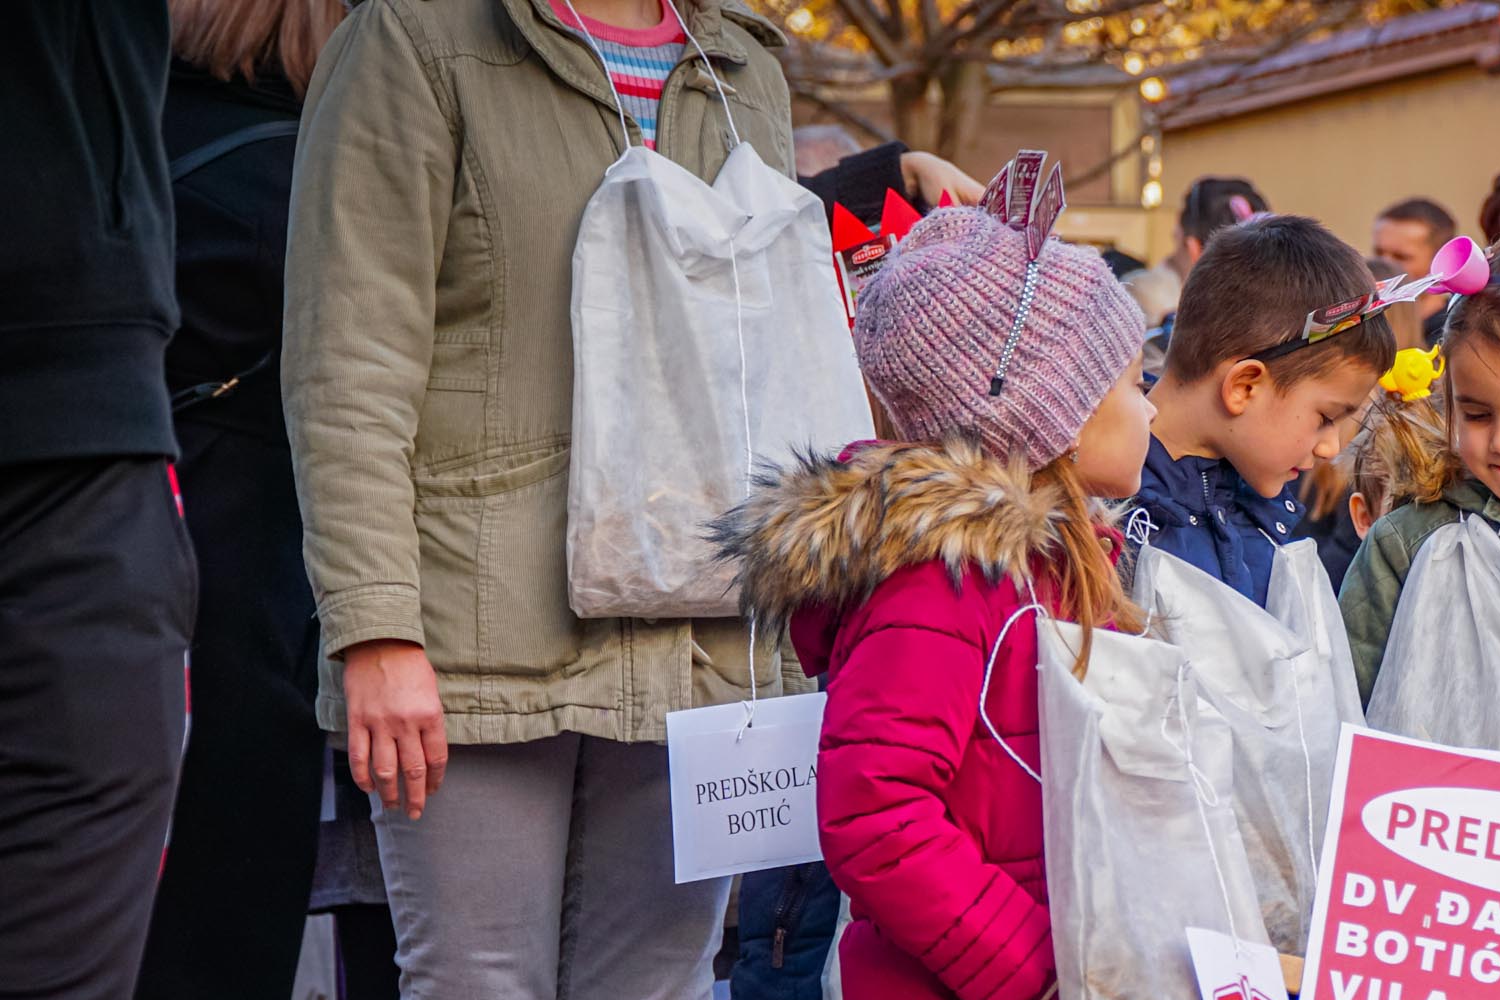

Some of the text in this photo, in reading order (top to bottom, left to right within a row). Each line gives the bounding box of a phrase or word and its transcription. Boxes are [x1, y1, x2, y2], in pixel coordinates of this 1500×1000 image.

[695, 763, 818, 804] PREDŠKOLA
[728, 798, 792, 835] BOTIĆ
[1342, 870, 1417, 915] DV
